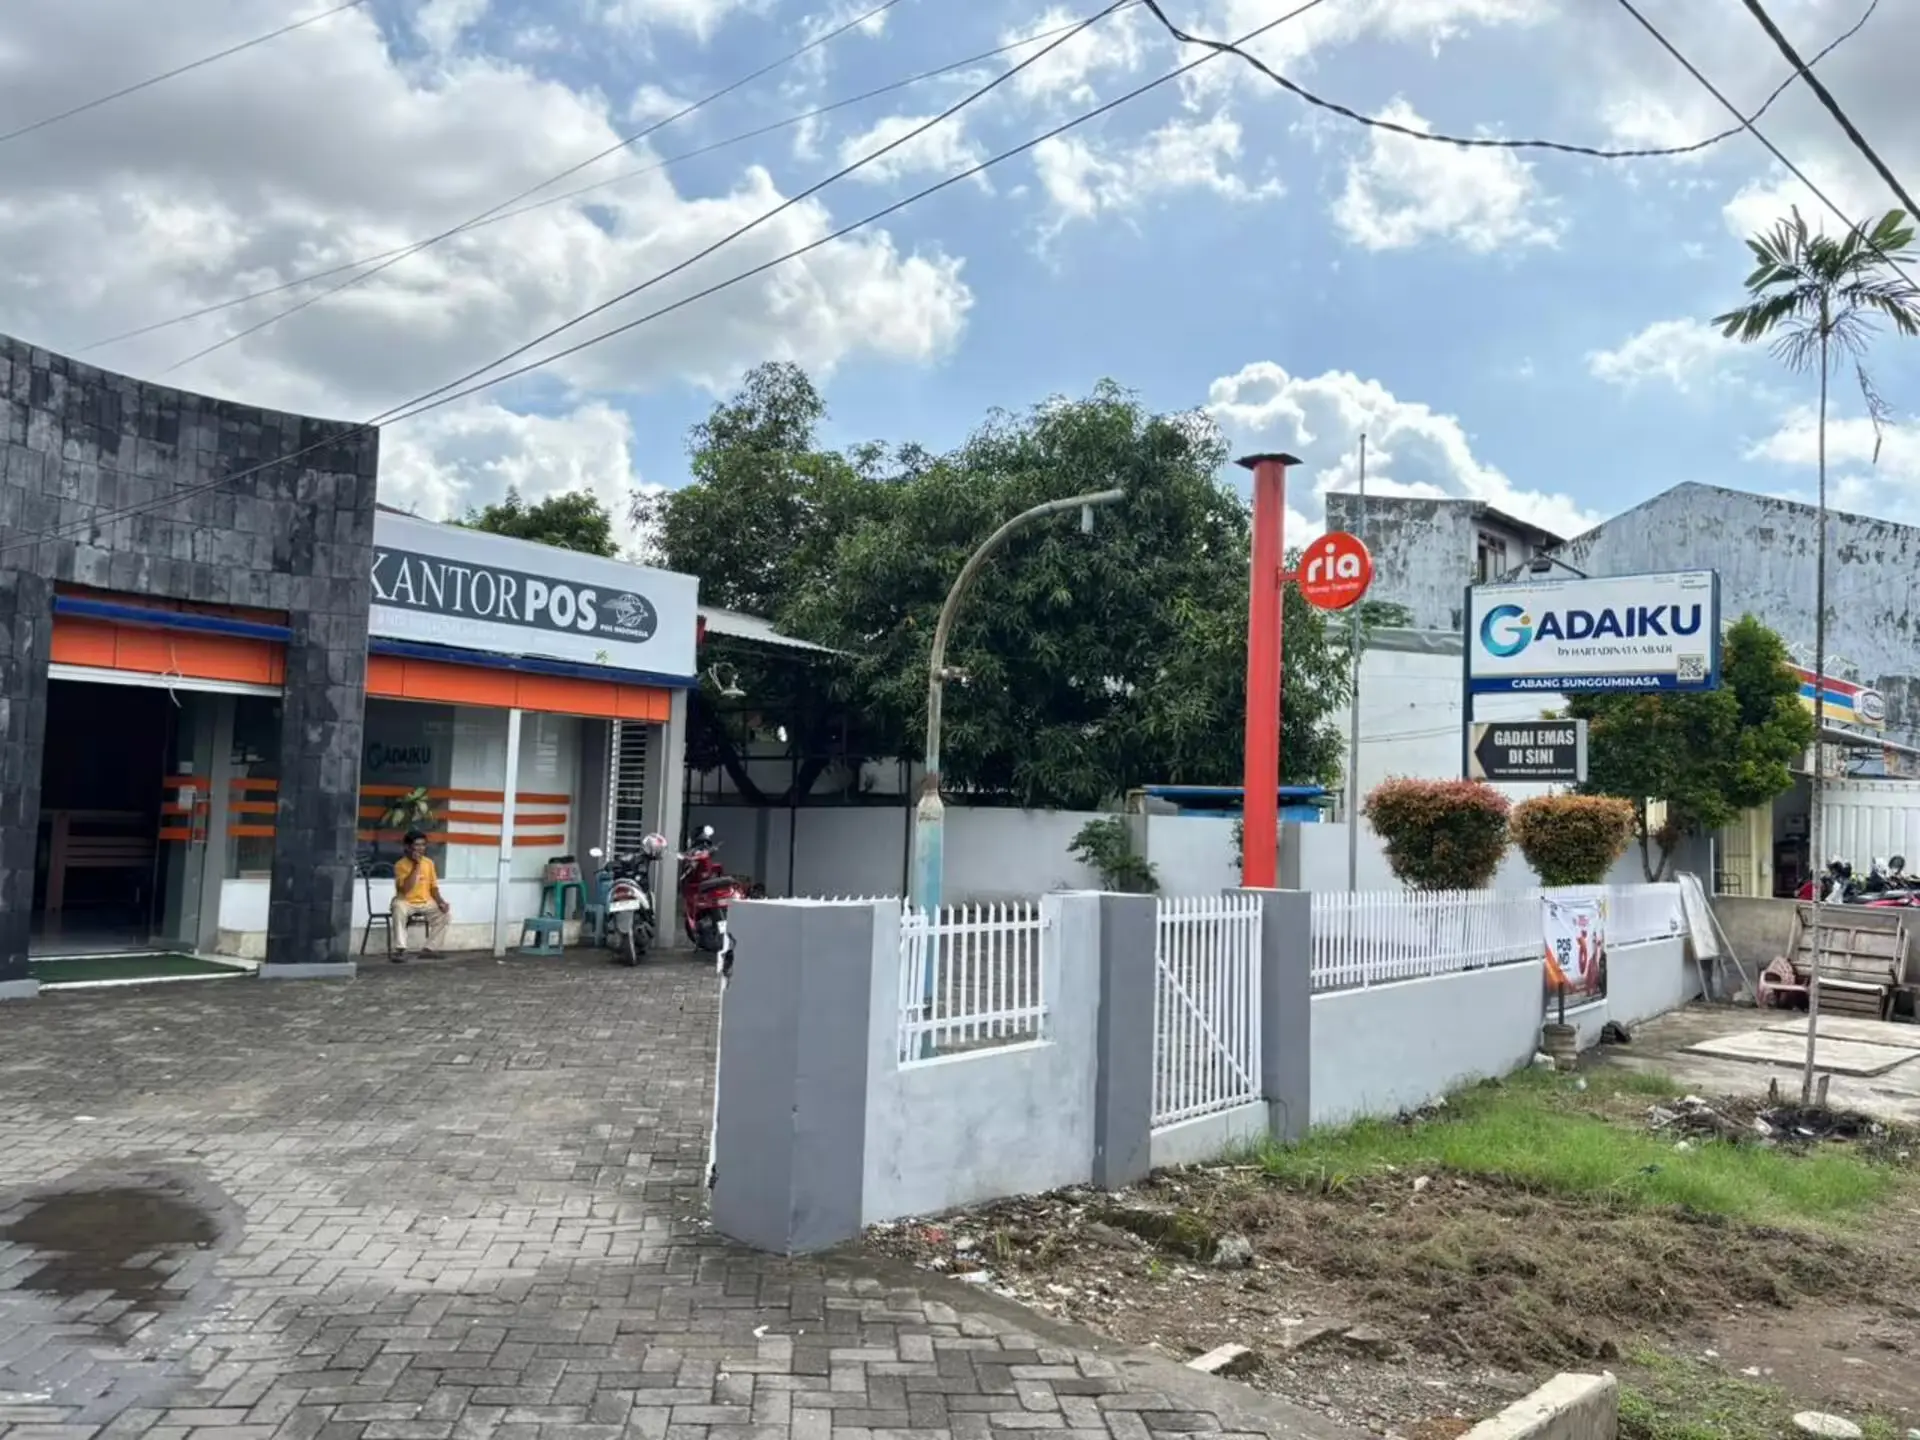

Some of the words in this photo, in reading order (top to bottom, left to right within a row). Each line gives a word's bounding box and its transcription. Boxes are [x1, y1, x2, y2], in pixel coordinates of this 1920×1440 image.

[1307, 543, 1360, 582] ria
[371, 552, 520, 619] KANTOR
[524, 579, 598, 632] POS
[1480, 604, 1702, 657] GADAIKU
[1557, 647, 1569, 656] by
[1571, 646, 1638, 656] HARTADINATA
[1641, 644, 1672, 654] ABADI
[1511, 678, 1560, 688] CABANG
[1562, 676, 1660, 688] SUNGGUMINASA
[1494, 730, 1534, 746] GADAI
[1537, 730, 1575, 745] EMAS
[1508, 749, 1523, 764] DI
[1525, 749, 1554, 764] SINI
